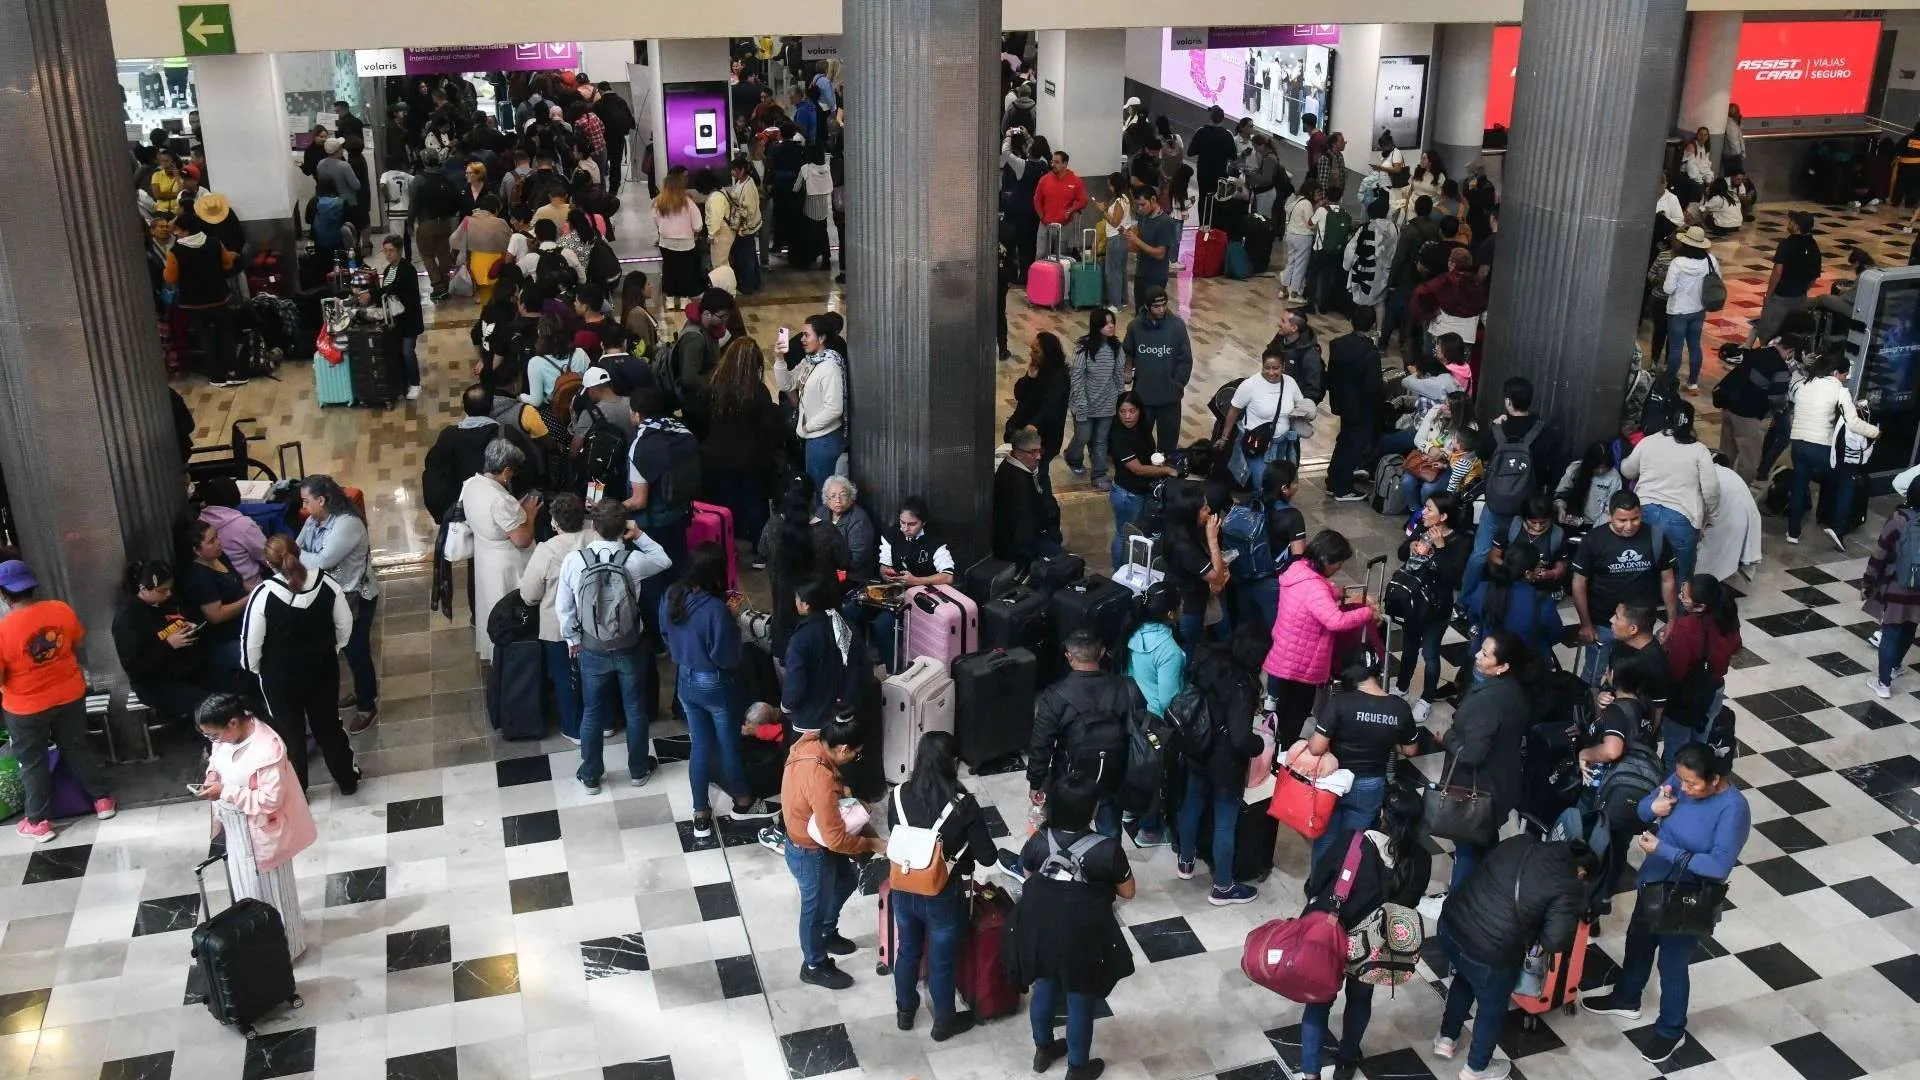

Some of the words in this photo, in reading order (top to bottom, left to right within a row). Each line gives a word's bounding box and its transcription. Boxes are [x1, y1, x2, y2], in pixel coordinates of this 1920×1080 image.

[1176, 37, 1202, 45] volaris
[808, 47, 837, 55] volaris
[363, 61, 398, 71] volaris
[1736, 58, 1802, 70] ASSIST
[1813, 57, 1846, 67] VIAJAS
[1755, 69, 1804, 81] CARD
[1811, 69, 1852, 79] SEGURO
[1138, 343, 1172, 358] Google
[1356, 711, 1399, 725] FIGUEROA
